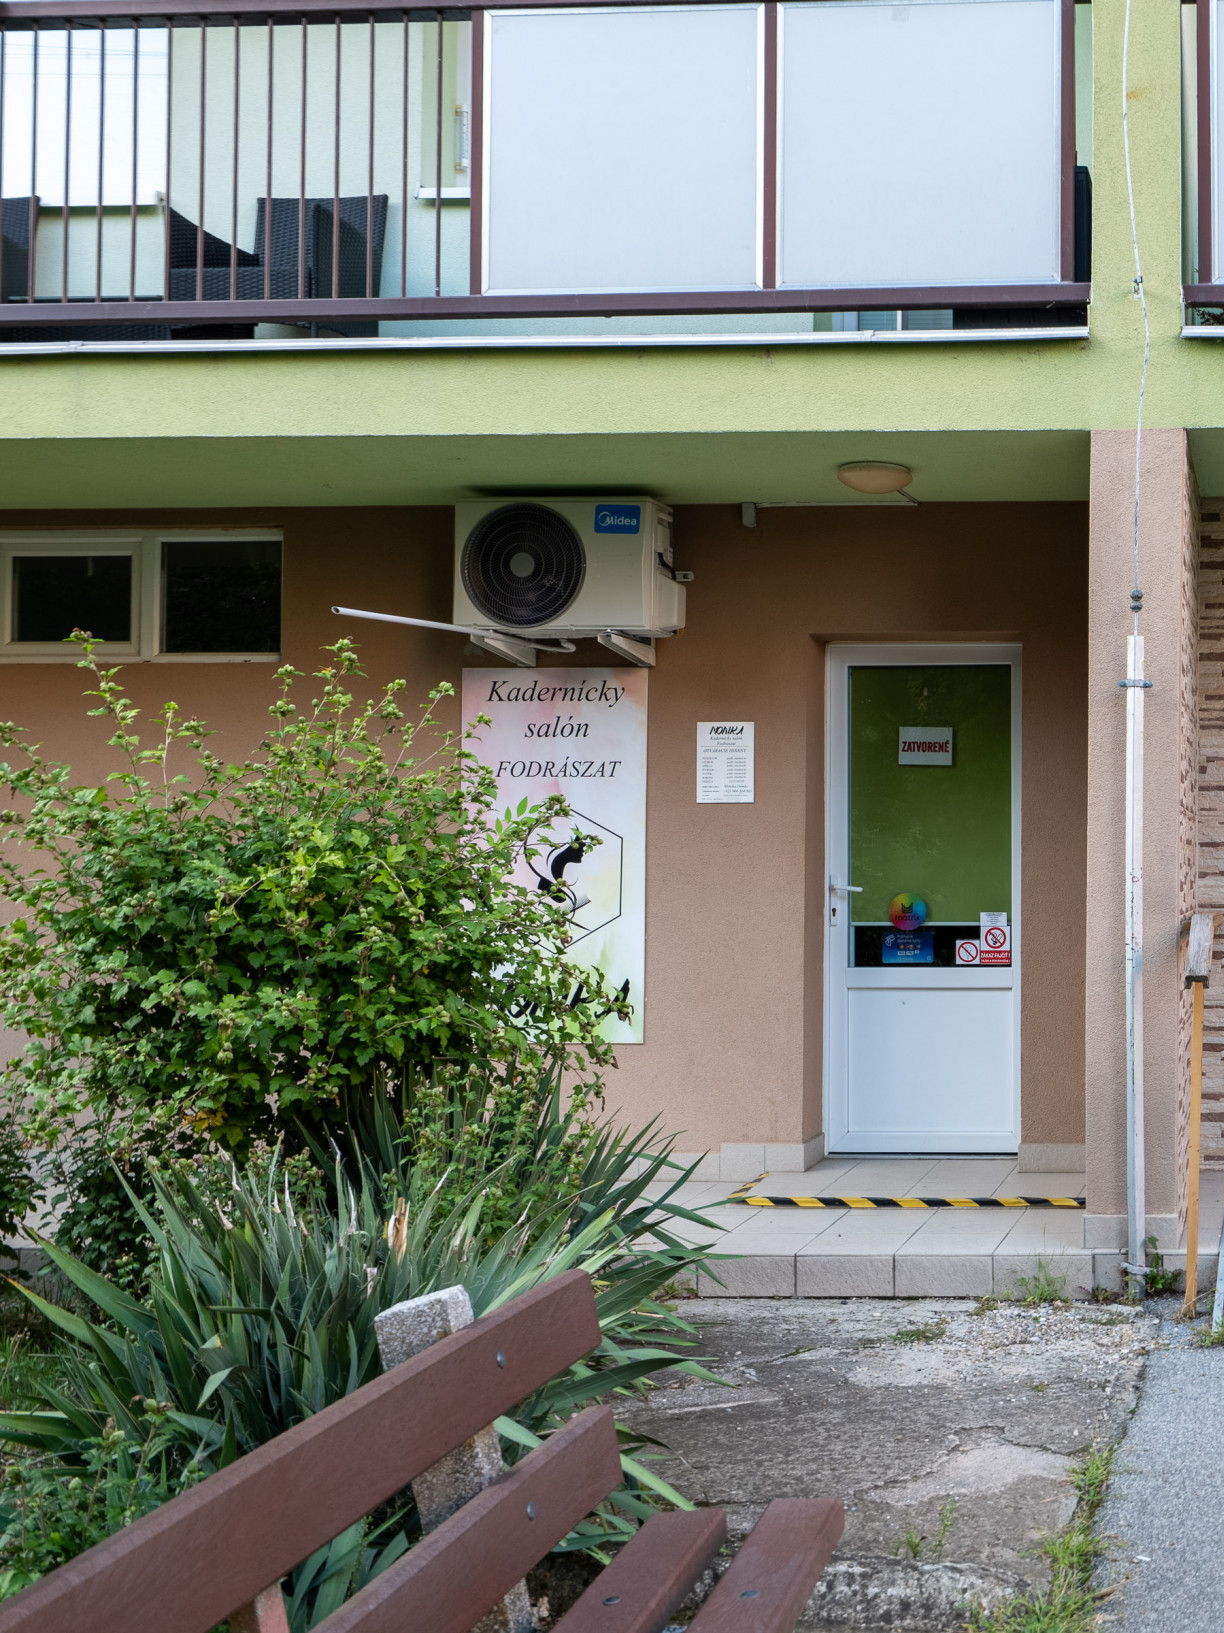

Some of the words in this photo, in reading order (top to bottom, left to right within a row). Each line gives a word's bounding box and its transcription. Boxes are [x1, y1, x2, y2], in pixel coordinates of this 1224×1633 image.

[598, 511, 637, 526] Midea
[486, 680, 625, 707] Kadernícky
[524, 716, 589, 737] salón
[901, 740, 950, 753] ZATVORENÉ
[495, 756, 622, 778] FODRÁSZAT
